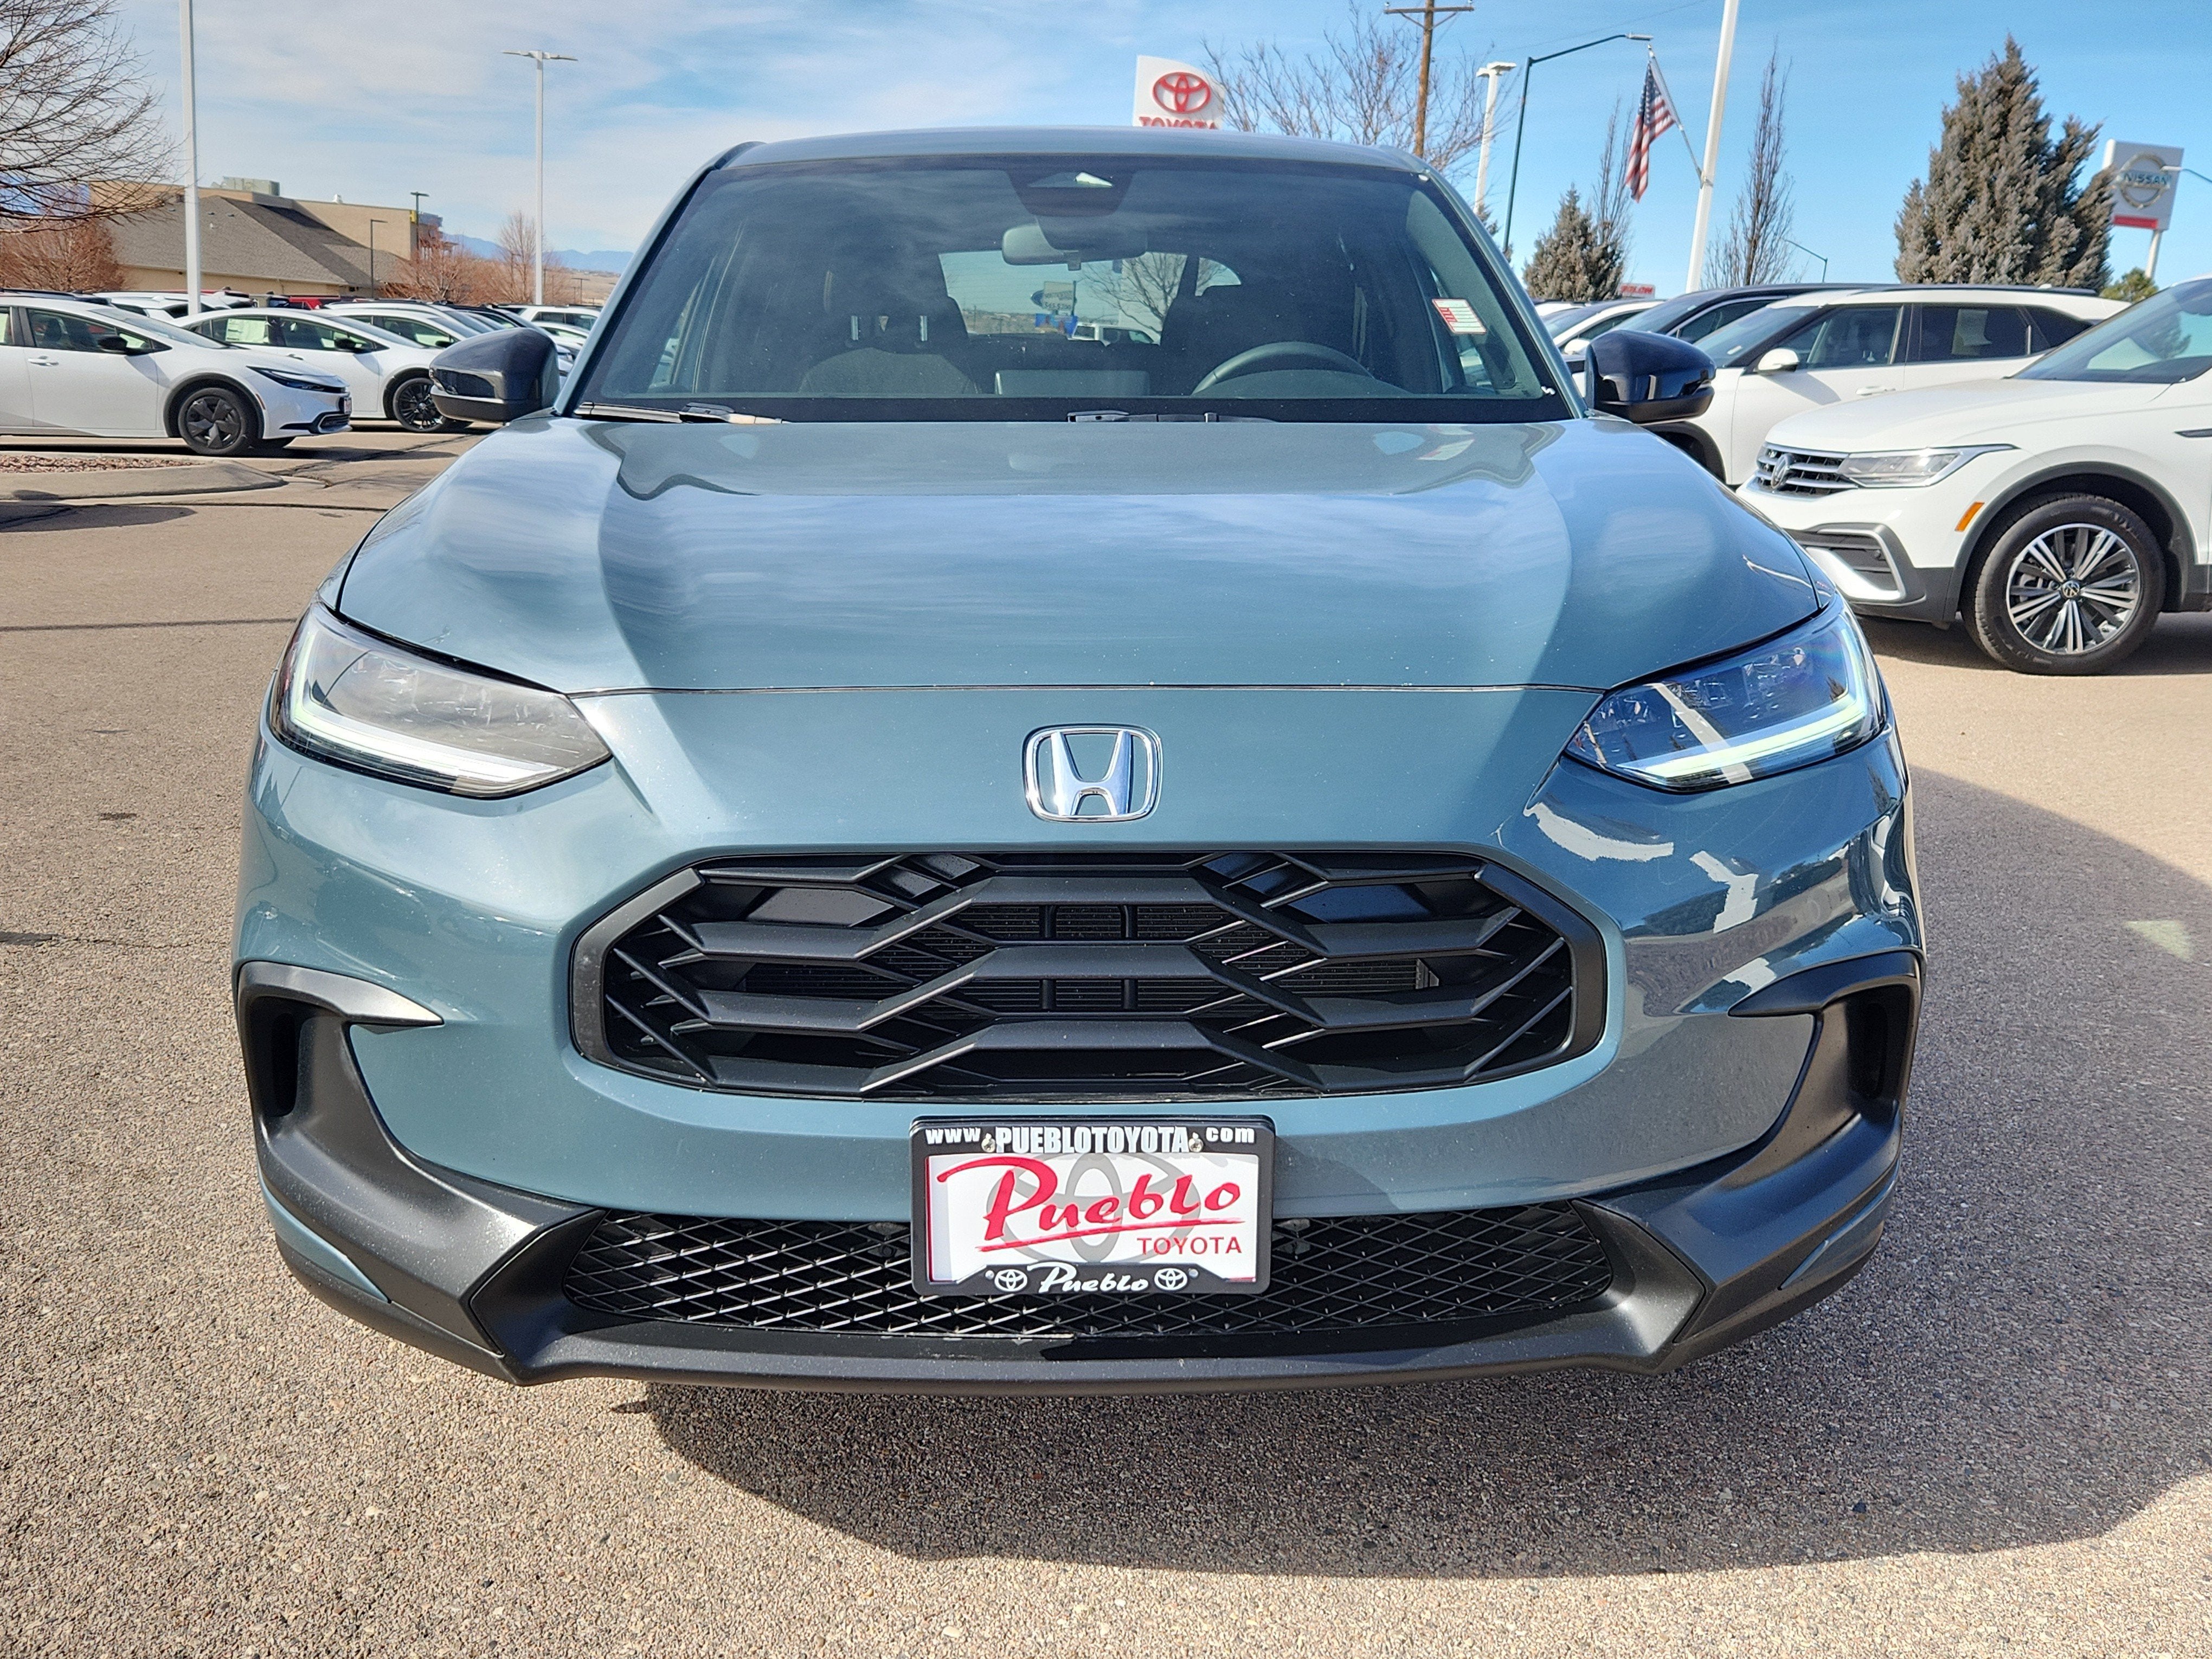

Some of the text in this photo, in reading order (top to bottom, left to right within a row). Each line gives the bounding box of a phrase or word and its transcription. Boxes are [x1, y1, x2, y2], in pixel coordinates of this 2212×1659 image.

[995, 1126, 1188, 1154] PUEBLOTOYOTA
[937, 1156, 1240, 1241] Pueblo
[1137, 1237, 1242, 1256] TOYOTA
[1026, 1262, 1149, 1293] Pueblo
